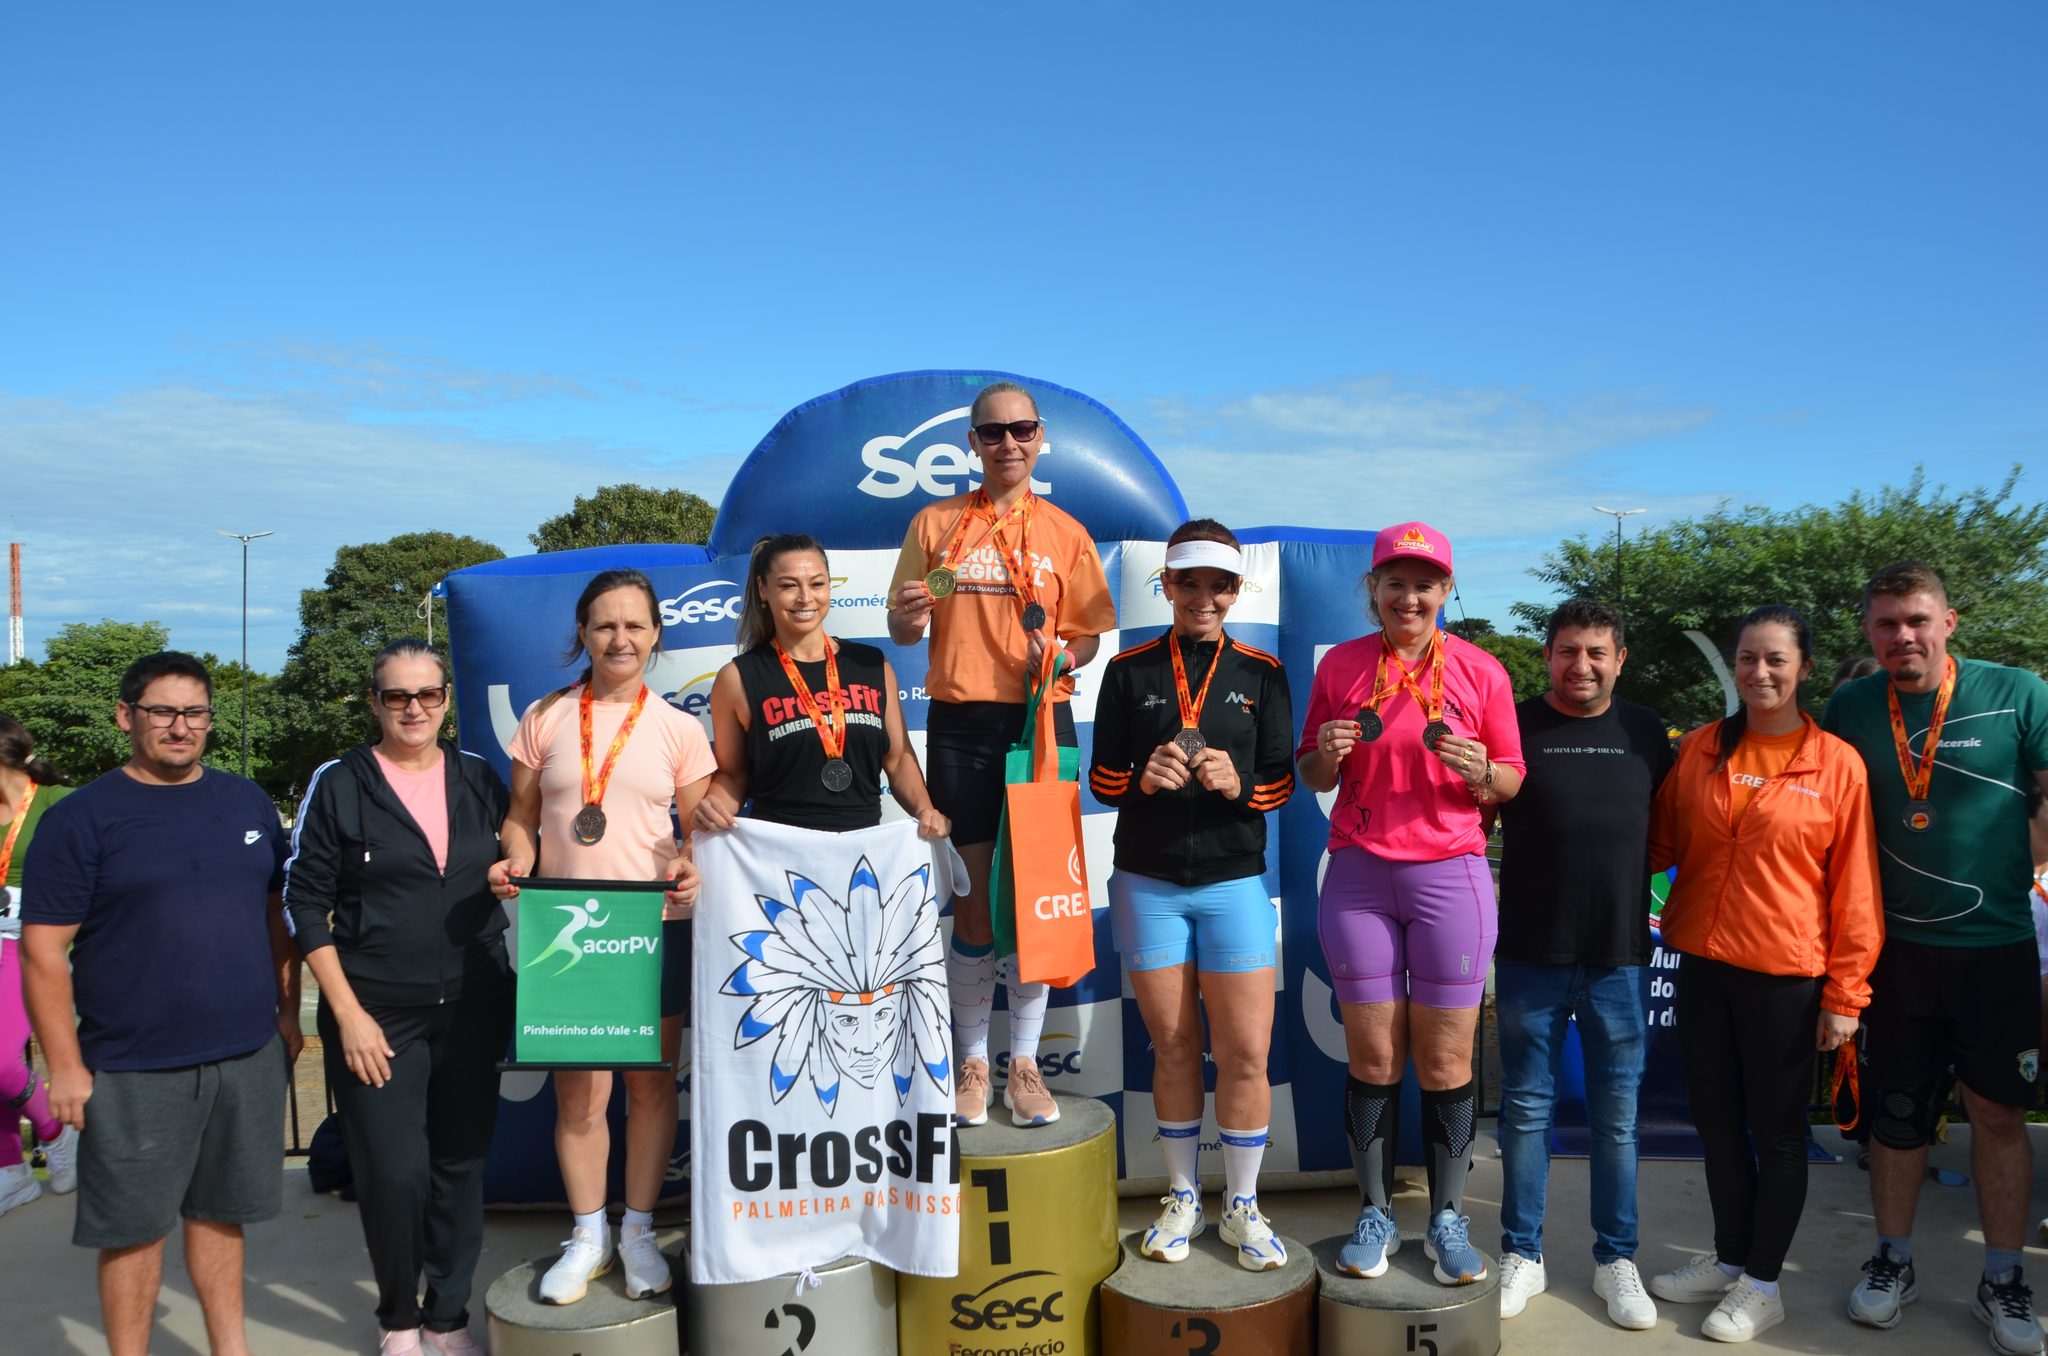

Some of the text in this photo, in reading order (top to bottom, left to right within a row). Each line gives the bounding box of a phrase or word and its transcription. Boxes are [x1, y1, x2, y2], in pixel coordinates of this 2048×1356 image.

[1244, 581, 1262, 593] RS
[1936, 738, 1982, 748] Acersic
[1732, 773, 1768, 789] CRE
[583, 936, 659, 954] acorPV
[591, 1025, 605, 1036] do
[606, 1025, 631, 1036] Vale
[639, 1025, 655, 1036] RS
[733, 1195, 851, 1220] PALMEIRA
[971, 1168, 1011, 1265] 1
